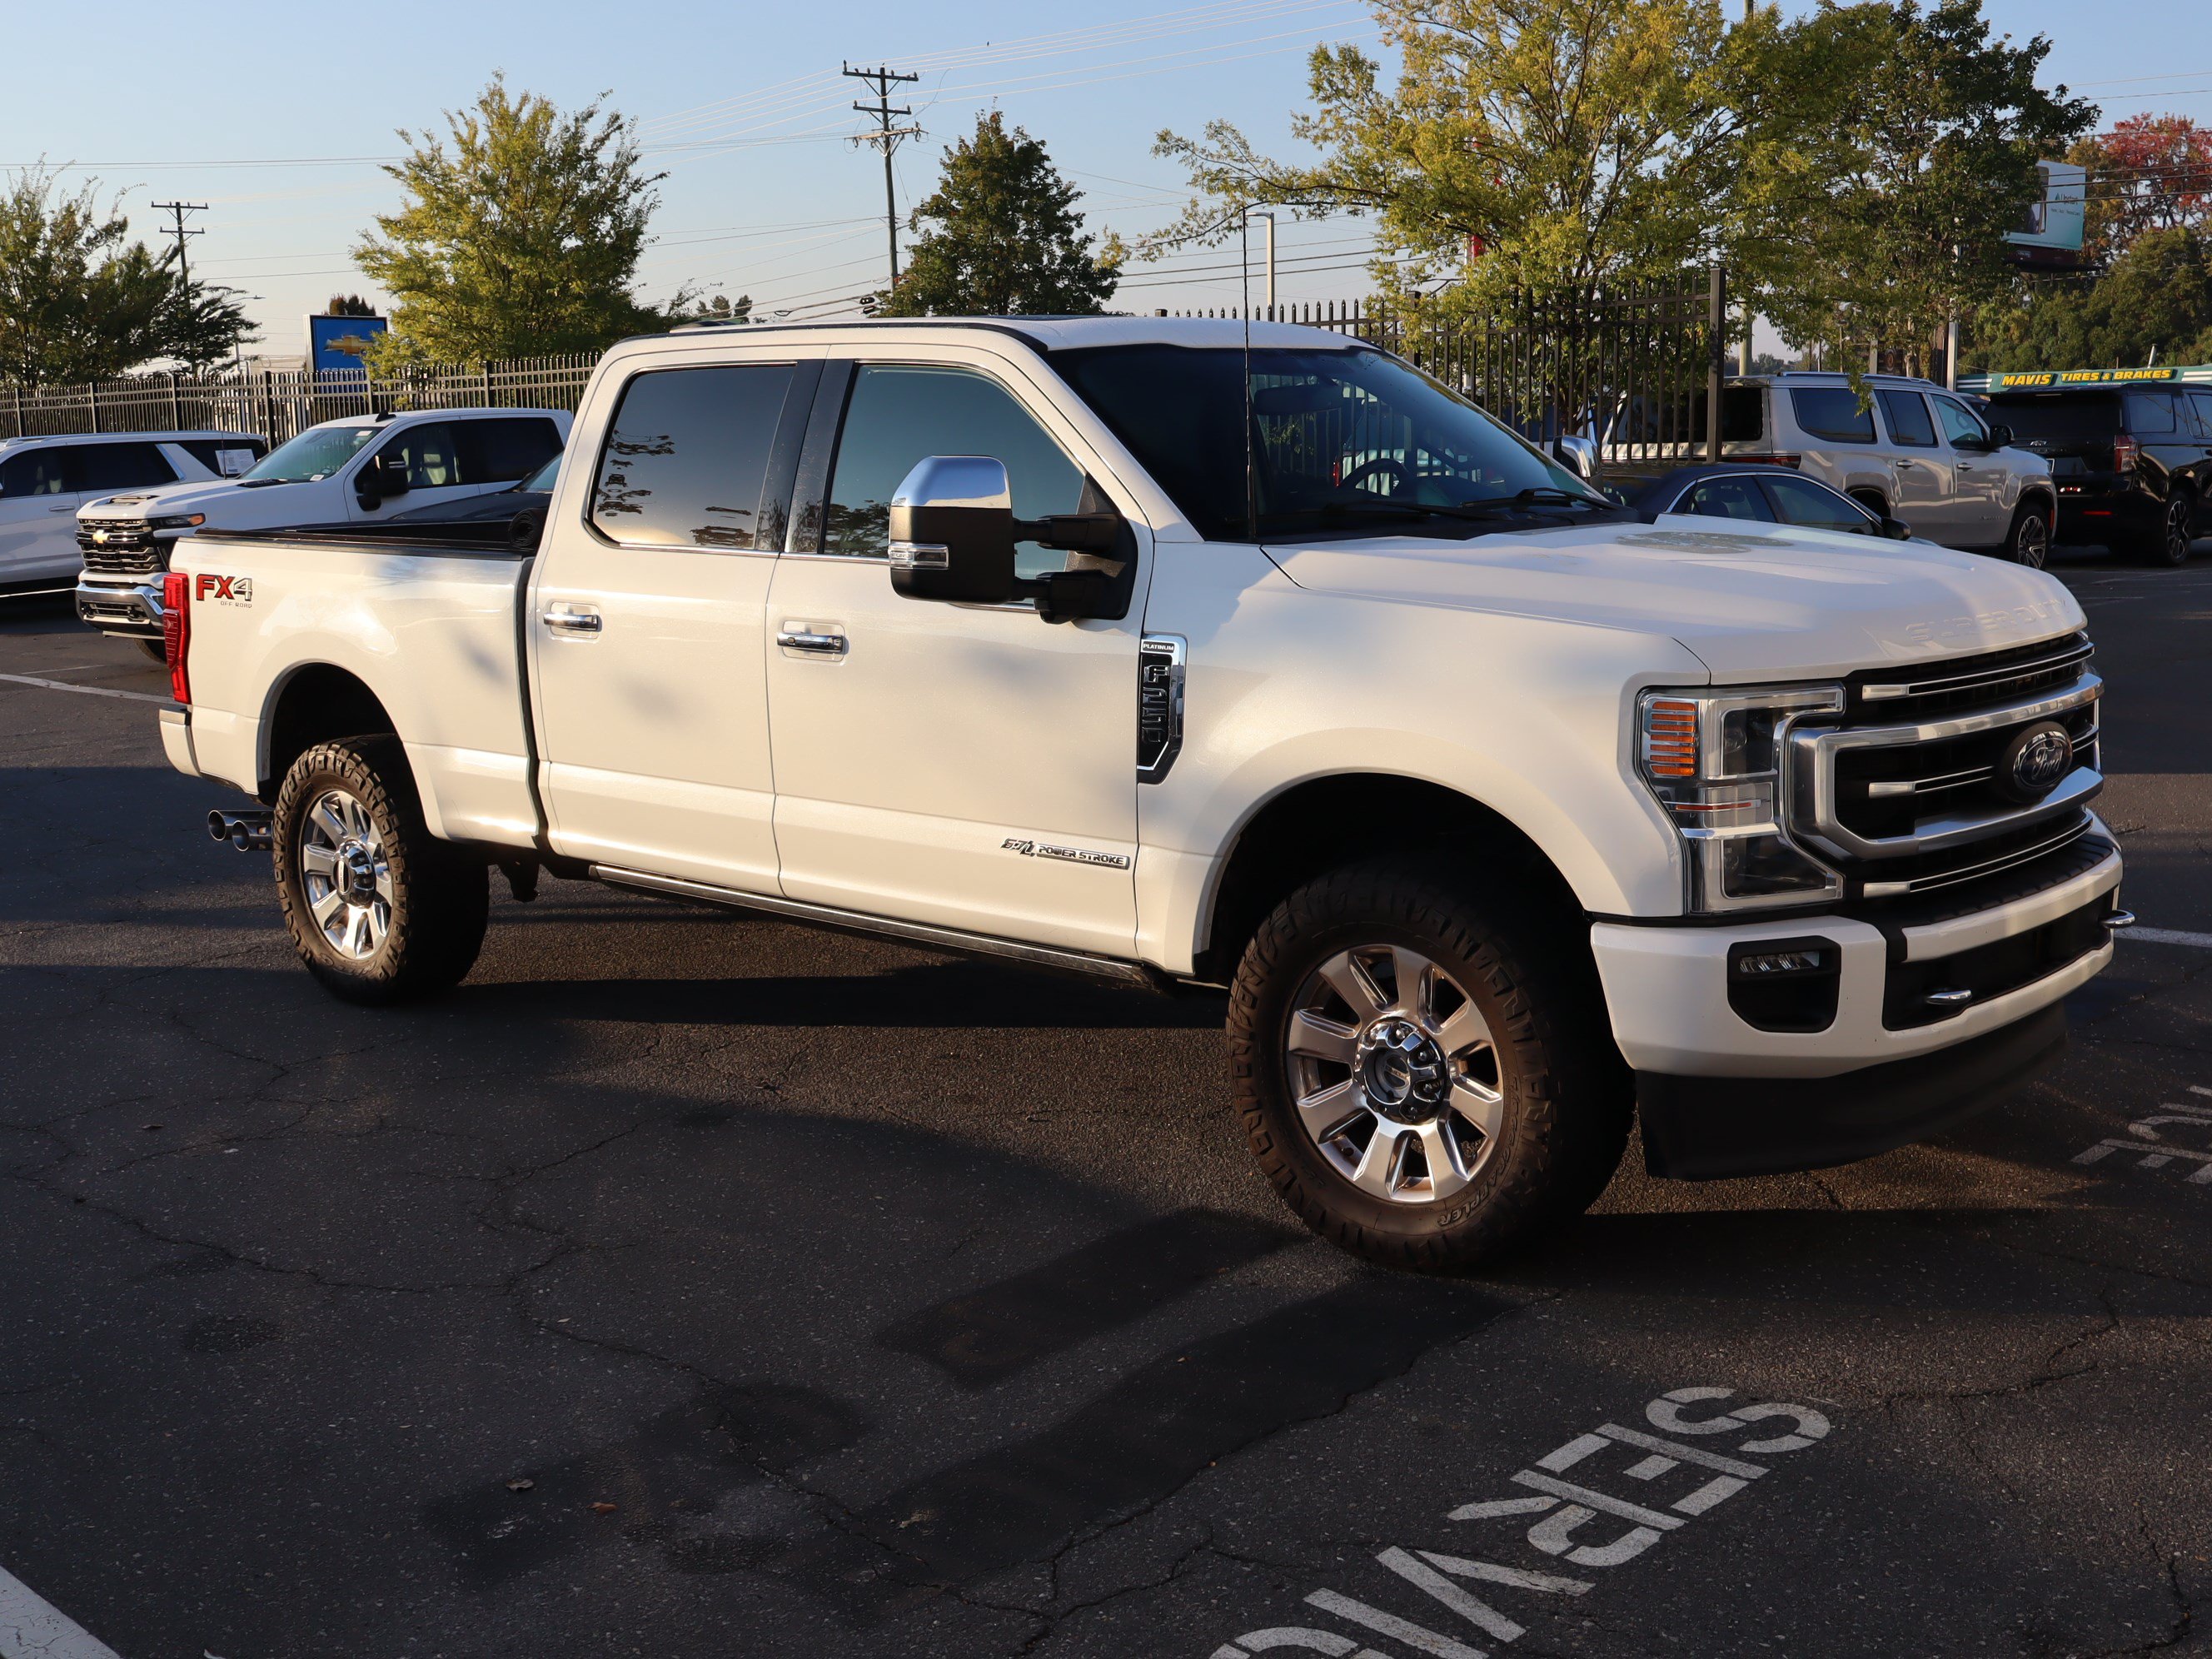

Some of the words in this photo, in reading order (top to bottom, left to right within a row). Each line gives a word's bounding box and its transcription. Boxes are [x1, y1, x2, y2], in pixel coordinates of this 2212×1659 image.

[2001, 374, 2053, 386] MAVIS
[2061, 371, 2100, 382] TIRES
[2103, 372, 2110, 381] &
[2114, 369, 2172, 381] BRAKES
[196, 573, 252, 601] FX4
[2033, 744, 2063, 780] Ford
[1039, 844, 1076, 858] POWER
[1079, 851, 1124, 865] STROKE
